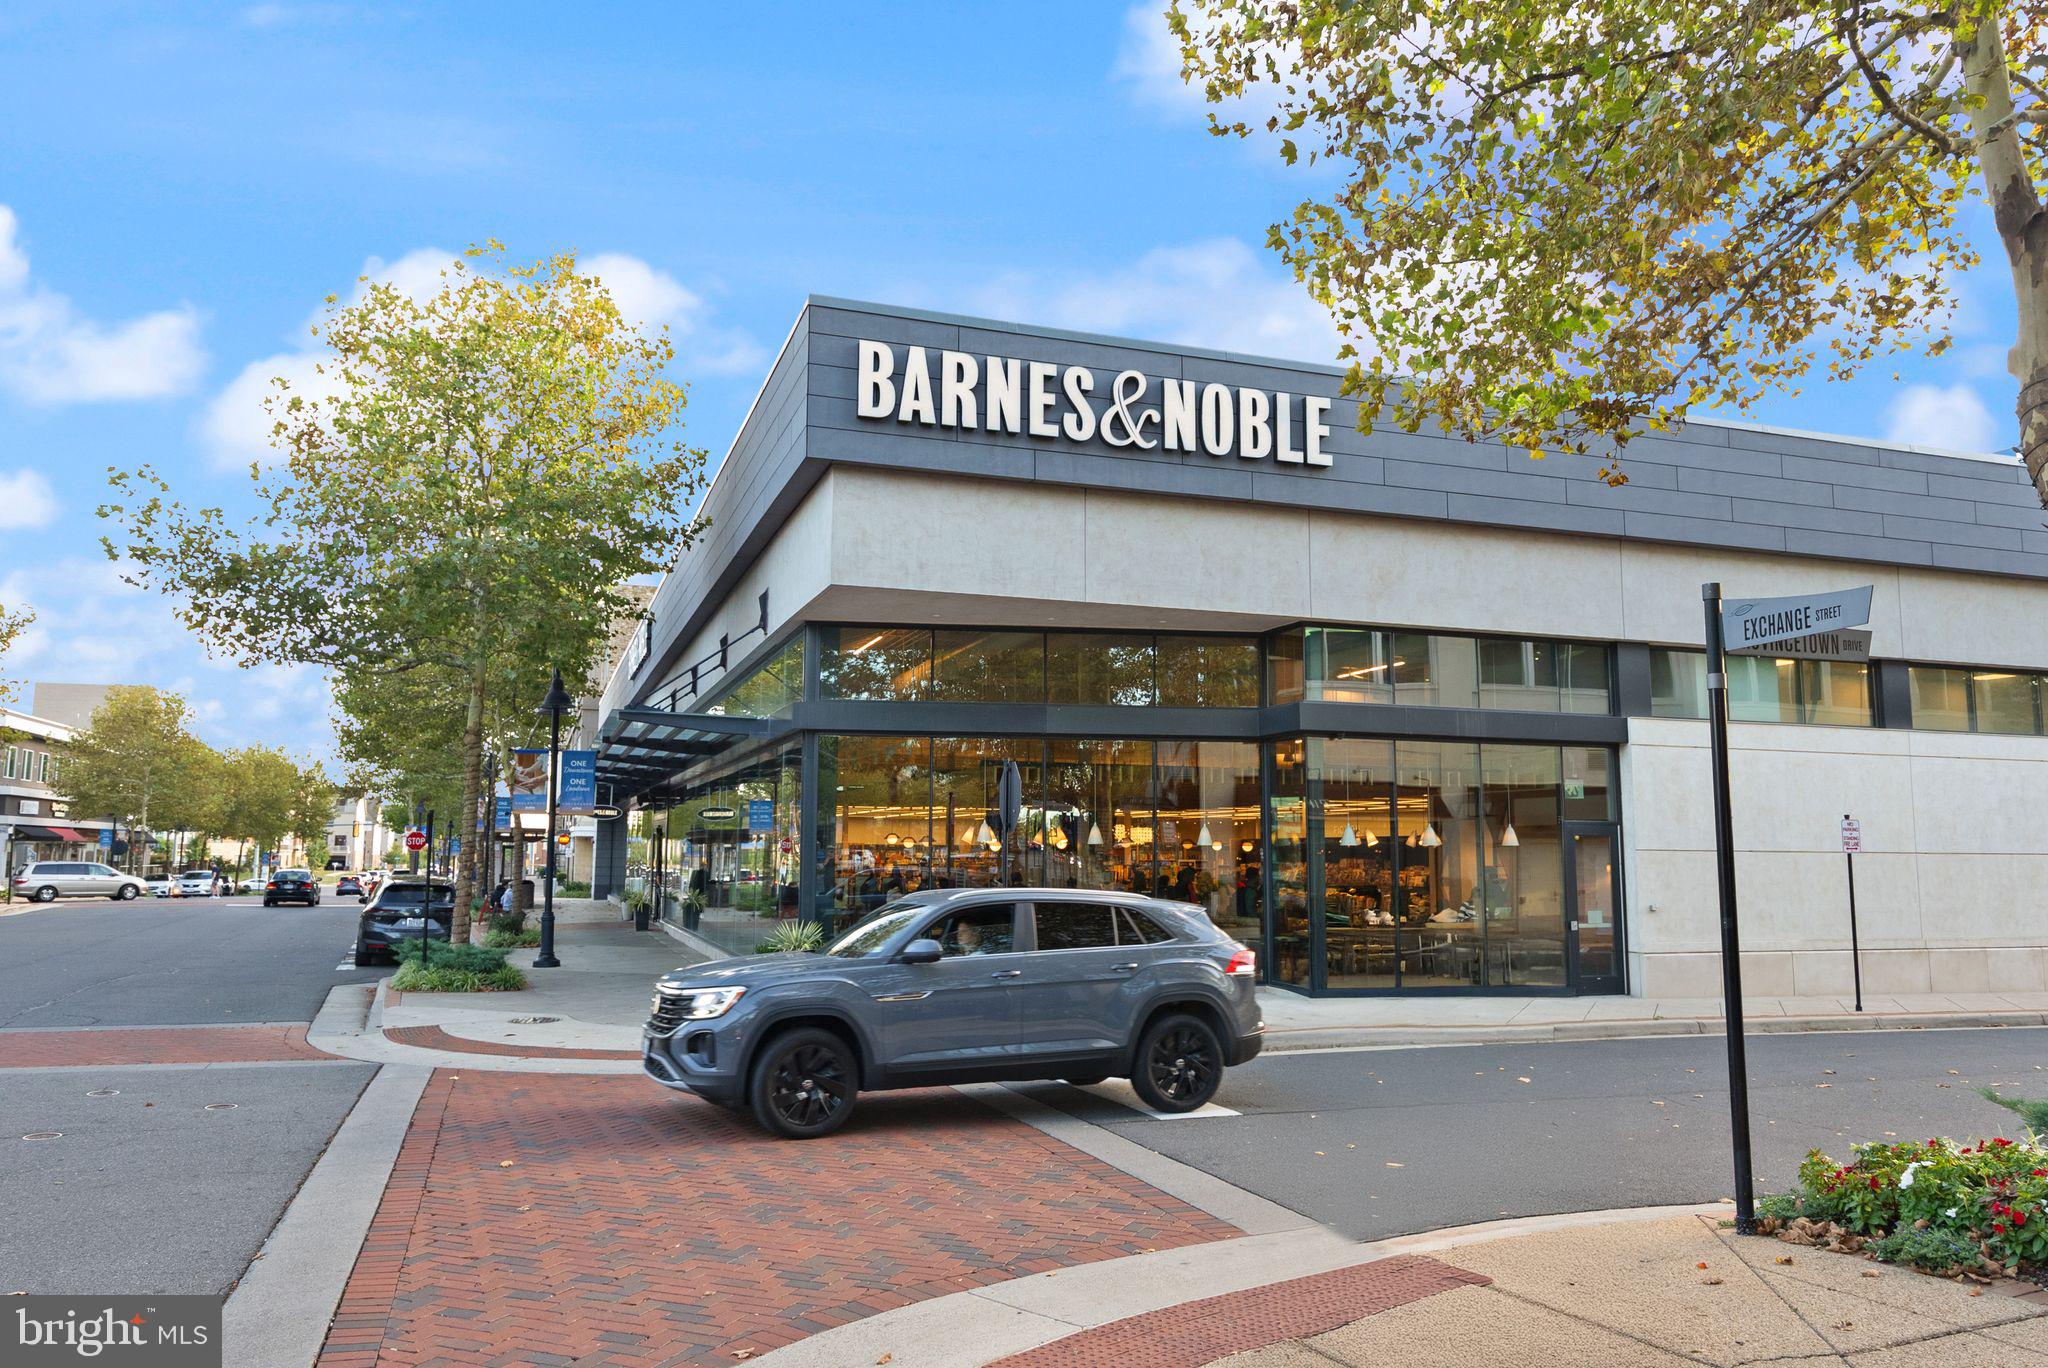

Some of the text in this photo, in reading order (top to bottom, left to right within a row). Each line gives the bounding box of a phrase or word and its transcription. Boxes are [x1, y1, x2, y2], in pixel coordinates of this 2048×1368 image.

[1744, 604, 1842, 641] EXCHANGE STREET
[1842, 638, 1863, 652] DRIVE
[407, 837, 426, 846] STOP
